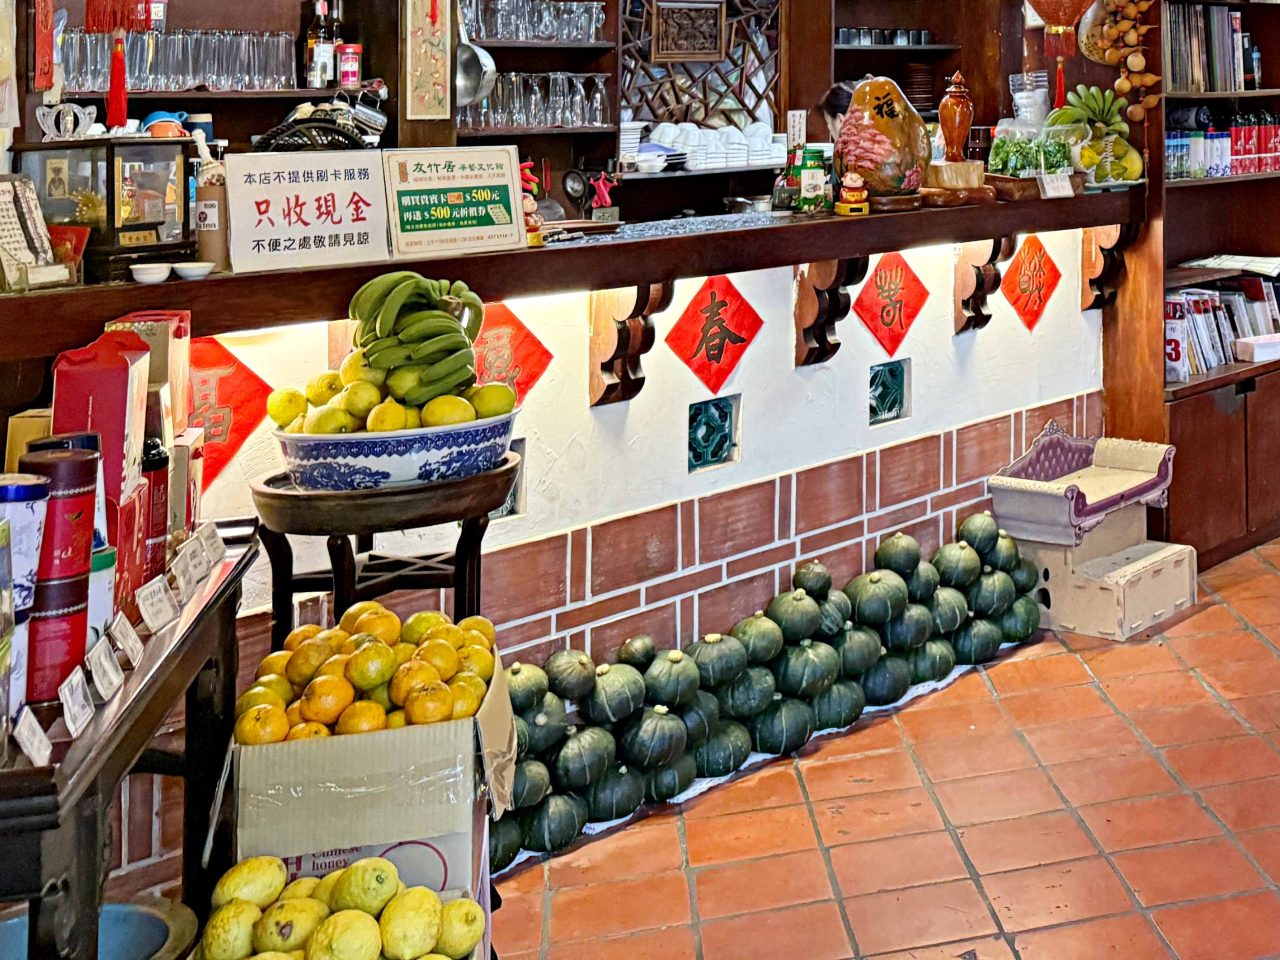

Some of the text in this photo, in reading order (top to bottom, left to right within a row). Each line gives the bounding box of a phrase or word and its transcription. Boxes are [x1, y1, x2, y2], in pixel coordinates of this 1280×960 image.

[872, 92, 900, 119] 福
[243, 167, 370, 186] 本店不提供刷卡服務
[412, 160, 456, 174] 友竹居
[253, 191, 372, 228] 只收現金
[251, 231, 370, 254] 不便之處敬請見諒
[692, 291, 748, 365] 春
[311, 858, 350, 872] honey
